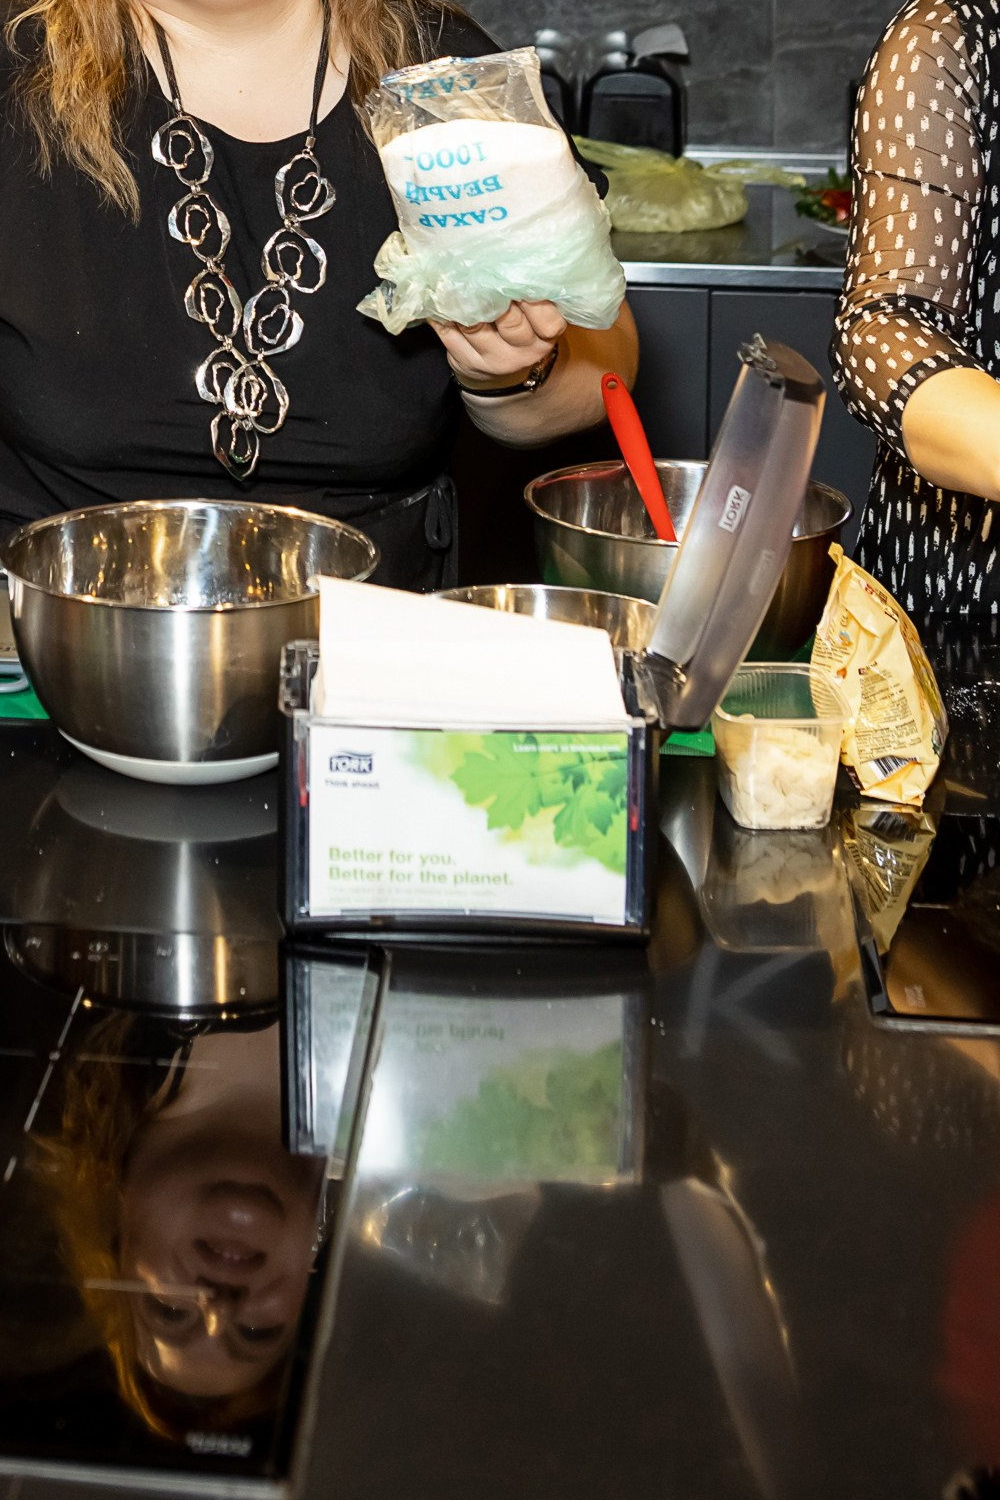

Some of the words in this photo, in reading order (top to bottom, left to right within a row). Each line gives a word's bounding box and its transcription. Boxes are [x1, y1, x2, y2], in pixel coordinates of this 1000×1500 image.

[401, 74, 477, 101] САХА
[405, 174, 503, 205] БЕЛЫЙ
[419, 206, 508, 229] САХАР
[331, 756, 372, 773] TORK
[328, 846, 383, 863] Better
[389, 848, 414, 863] for
[419, 852, 457, 867] you.
[328, 866, 383, 882] Better
[389, 868, 414, 882] for
[419, 869, 447, 884] the
[453, 870, 514, 887] planet.
